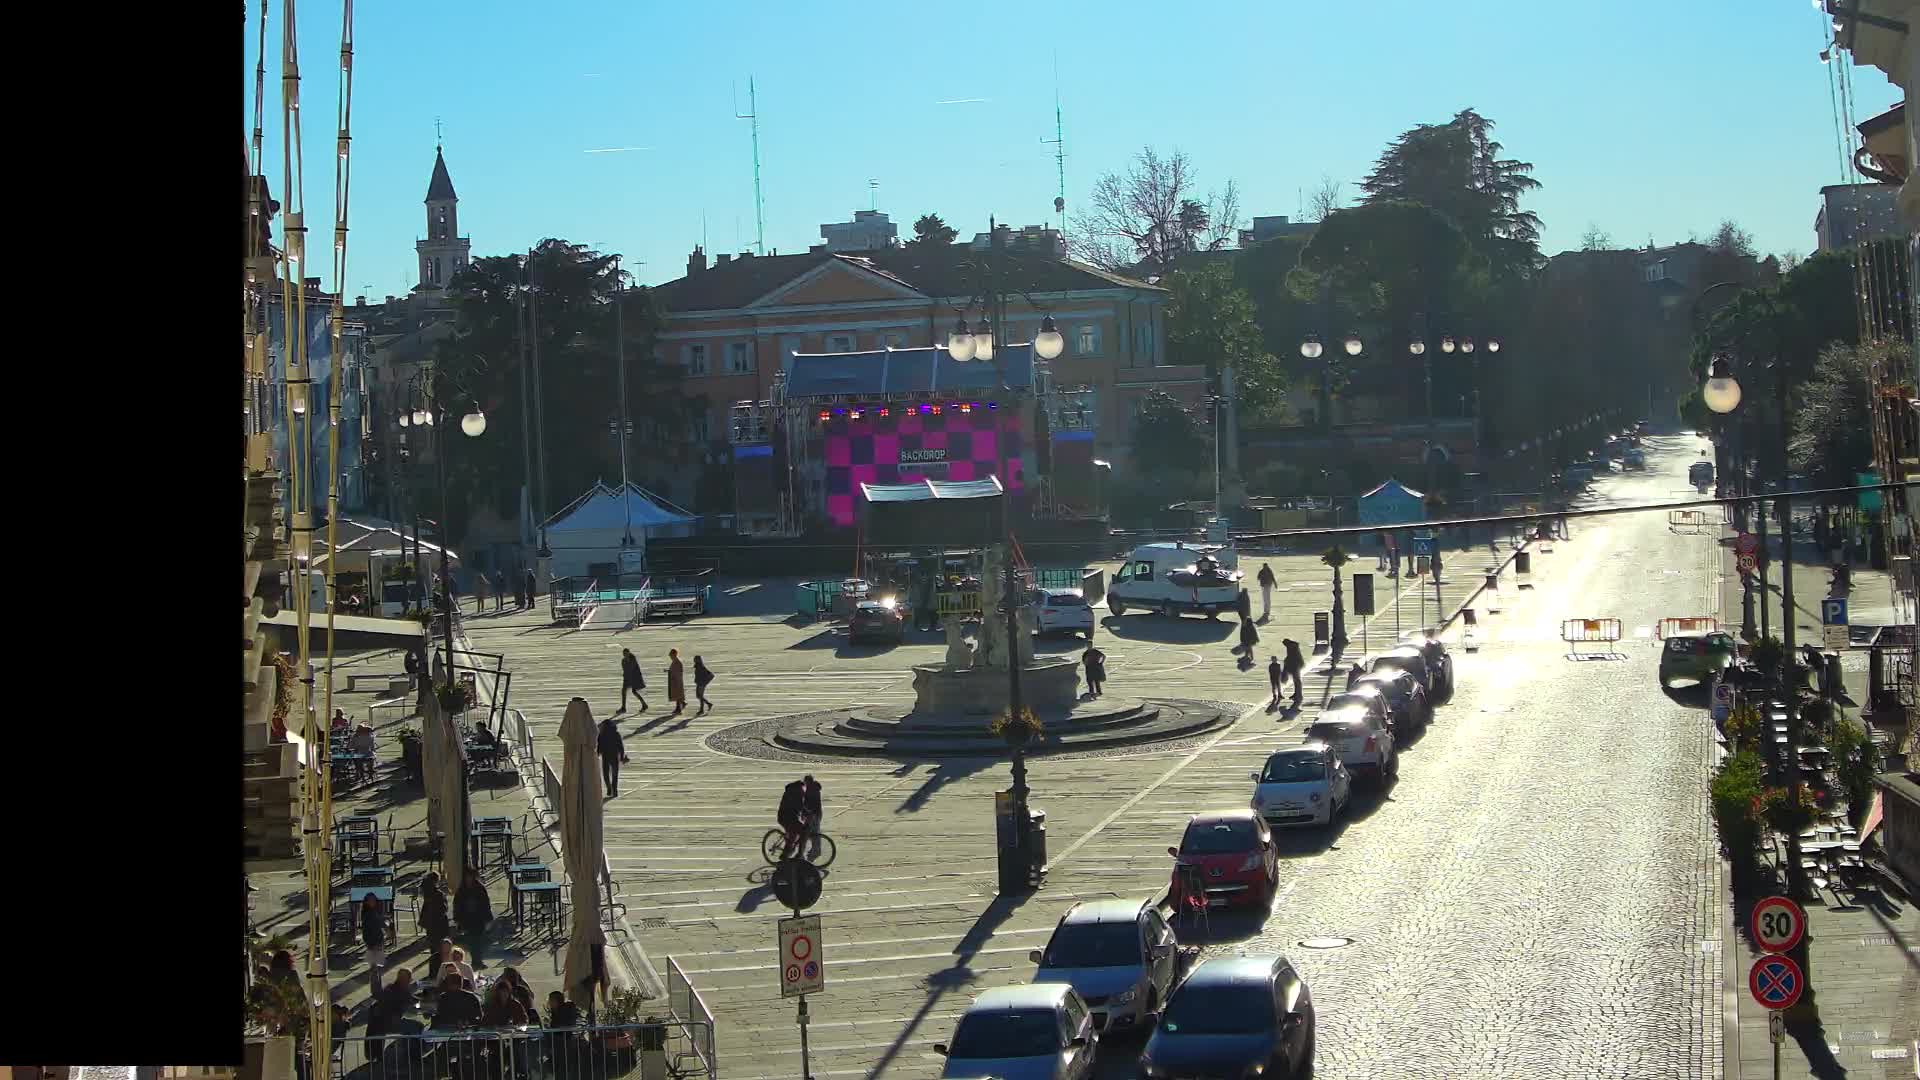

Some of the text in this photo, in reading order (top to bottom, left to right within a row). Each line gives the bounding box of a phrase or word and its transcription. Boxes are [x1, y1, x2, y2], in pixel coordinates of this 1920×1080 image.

[901, 450, 946, 460] BACKDROP
[1742, 558, 1753, 567] 20
[1827, 602, 1841, 622] P
[1762, 912, 1791, 938] 30
